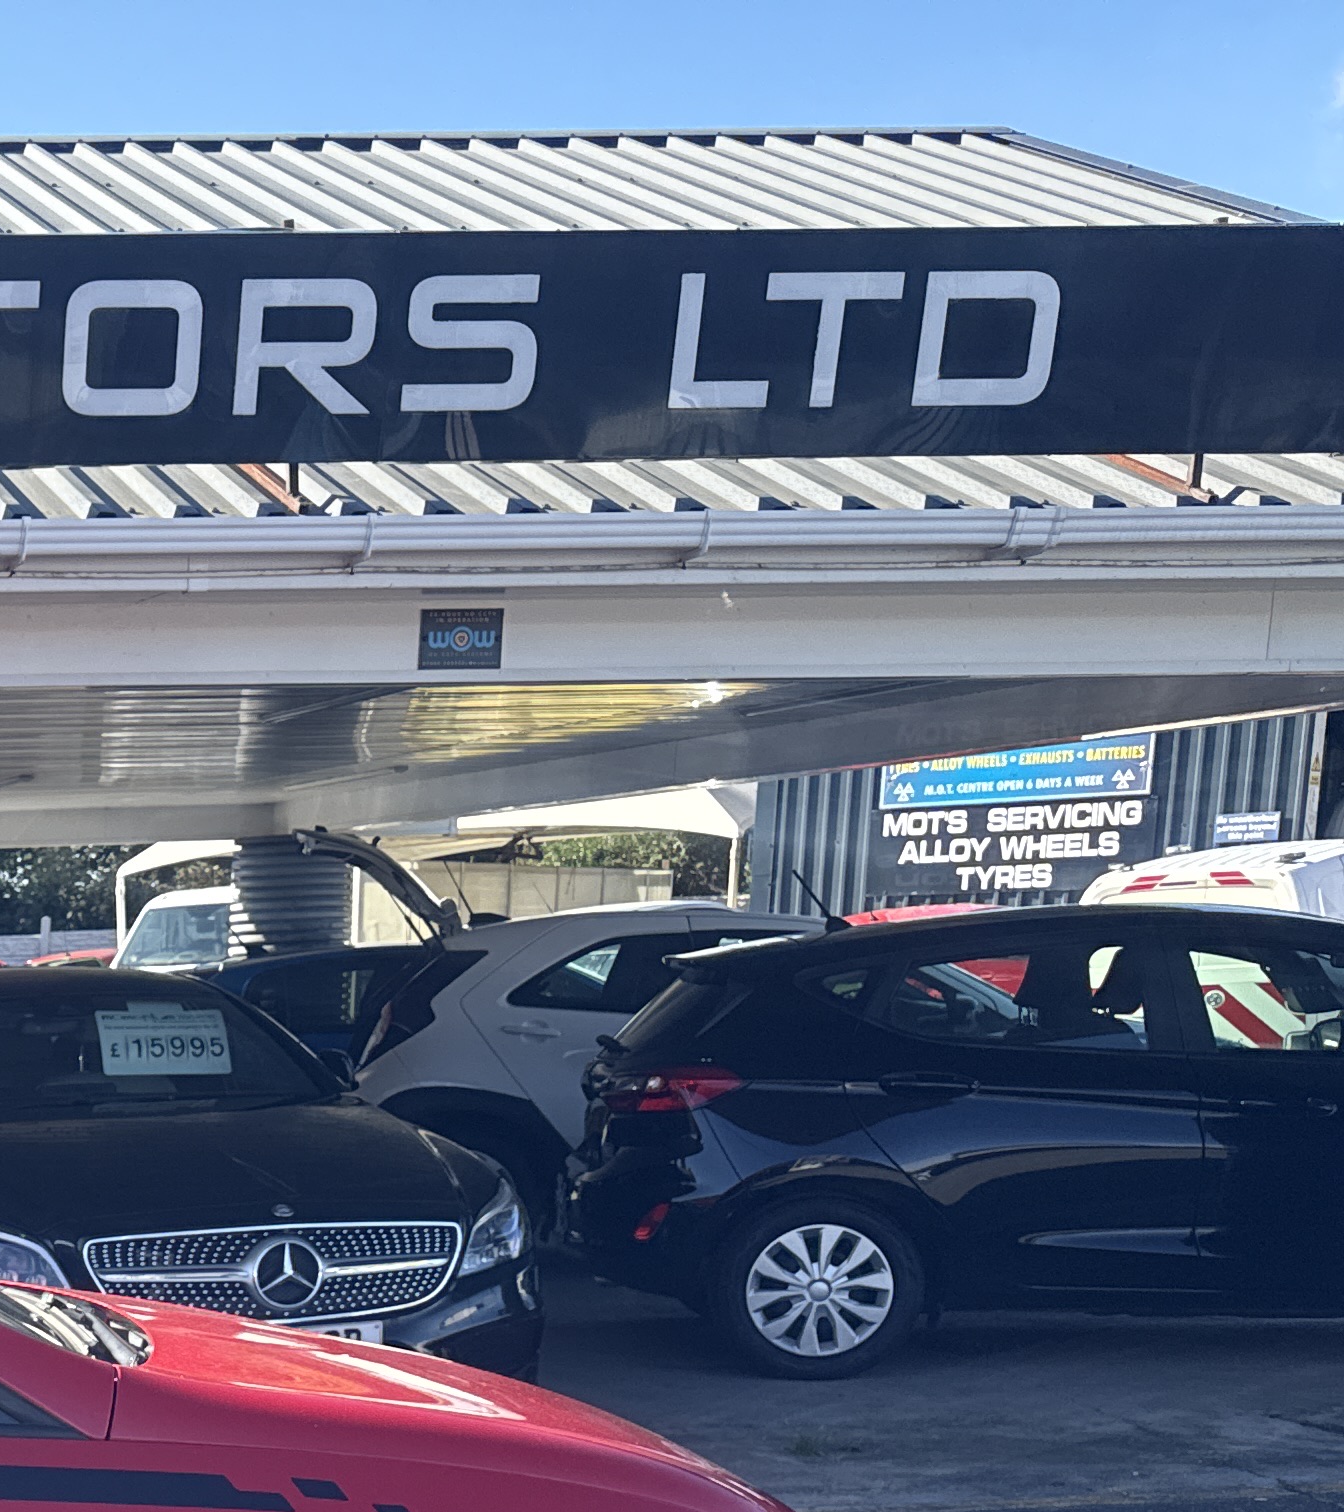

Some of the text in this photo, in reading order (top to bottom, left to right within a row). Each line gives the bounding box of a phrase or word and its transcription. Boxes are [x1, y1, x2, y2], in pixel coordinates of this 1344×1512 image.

[668, 270, 1061, 408] LTD
[930, 757, 964, 771] ALLOY
[966, 754, 1008, 769] WHEELS
[1018, 749, 1075, 765] EXHAUSTS
[1085, 745, 1145, 761] BATTERIES
[956, 781, 994, 794] CENTRE
[996, 779, 1024, 791] OPEN
[1035, 776, 1062, 789] DAYS
[1064, 776, 1072, 787] A
[1074, 775, 1104, 787] WEEK
[882, 800, 1143, 837] MOT'S SERVICING
[898, 831, 1120, 864] ALLOY WHEELS
[956, 863, 1053, 890] TYRES
